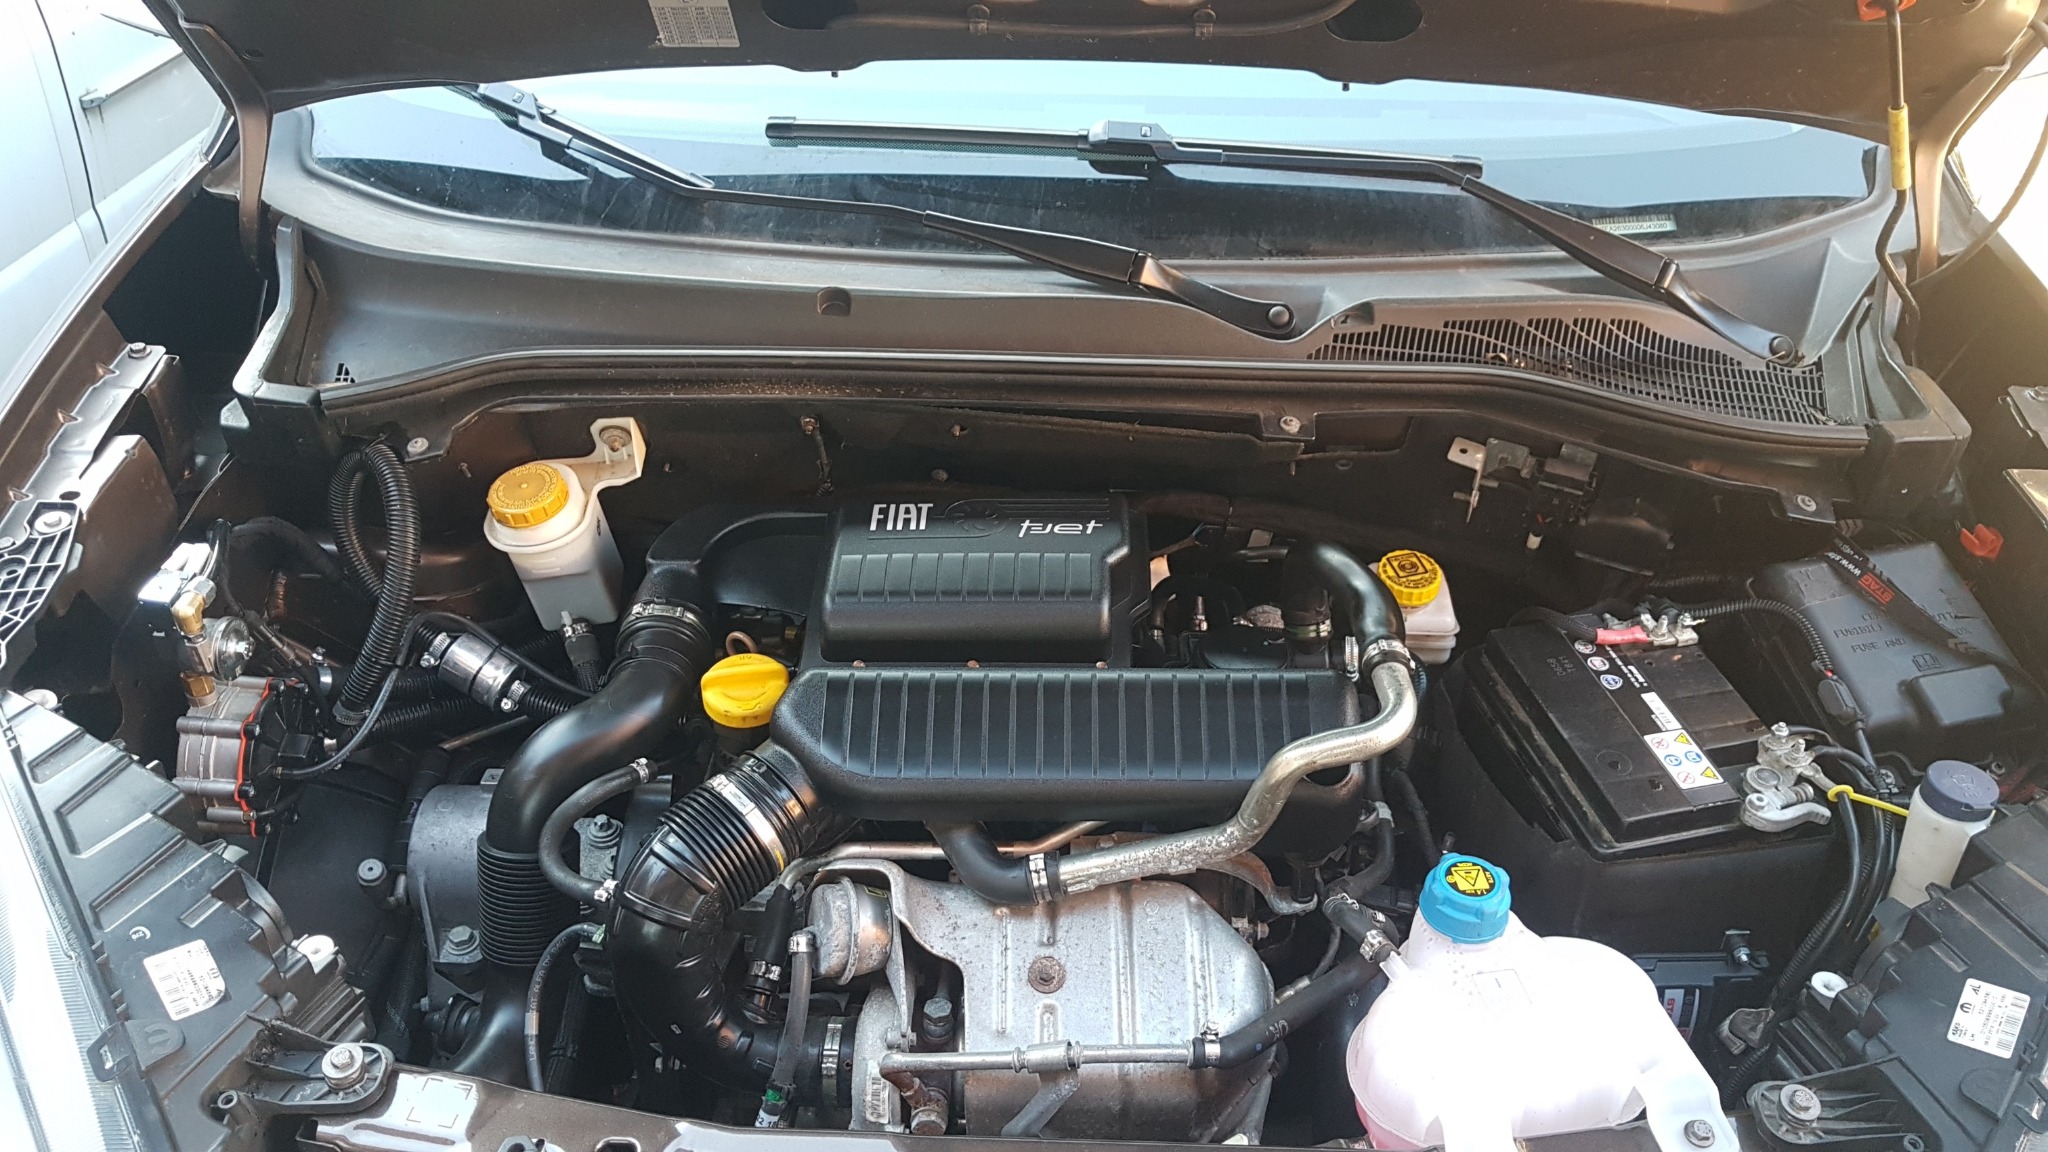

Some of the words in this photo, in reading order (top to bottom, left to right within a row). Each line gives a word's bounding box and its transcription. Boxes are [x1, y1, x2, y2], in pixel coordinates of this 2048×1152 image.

[869, 503, 934, 531] FIAT
[1860, 573, 1893, 602] STAG
[1851, 641, 1878, 653] FUSE
[533, 970, 546, 993] ALFA
